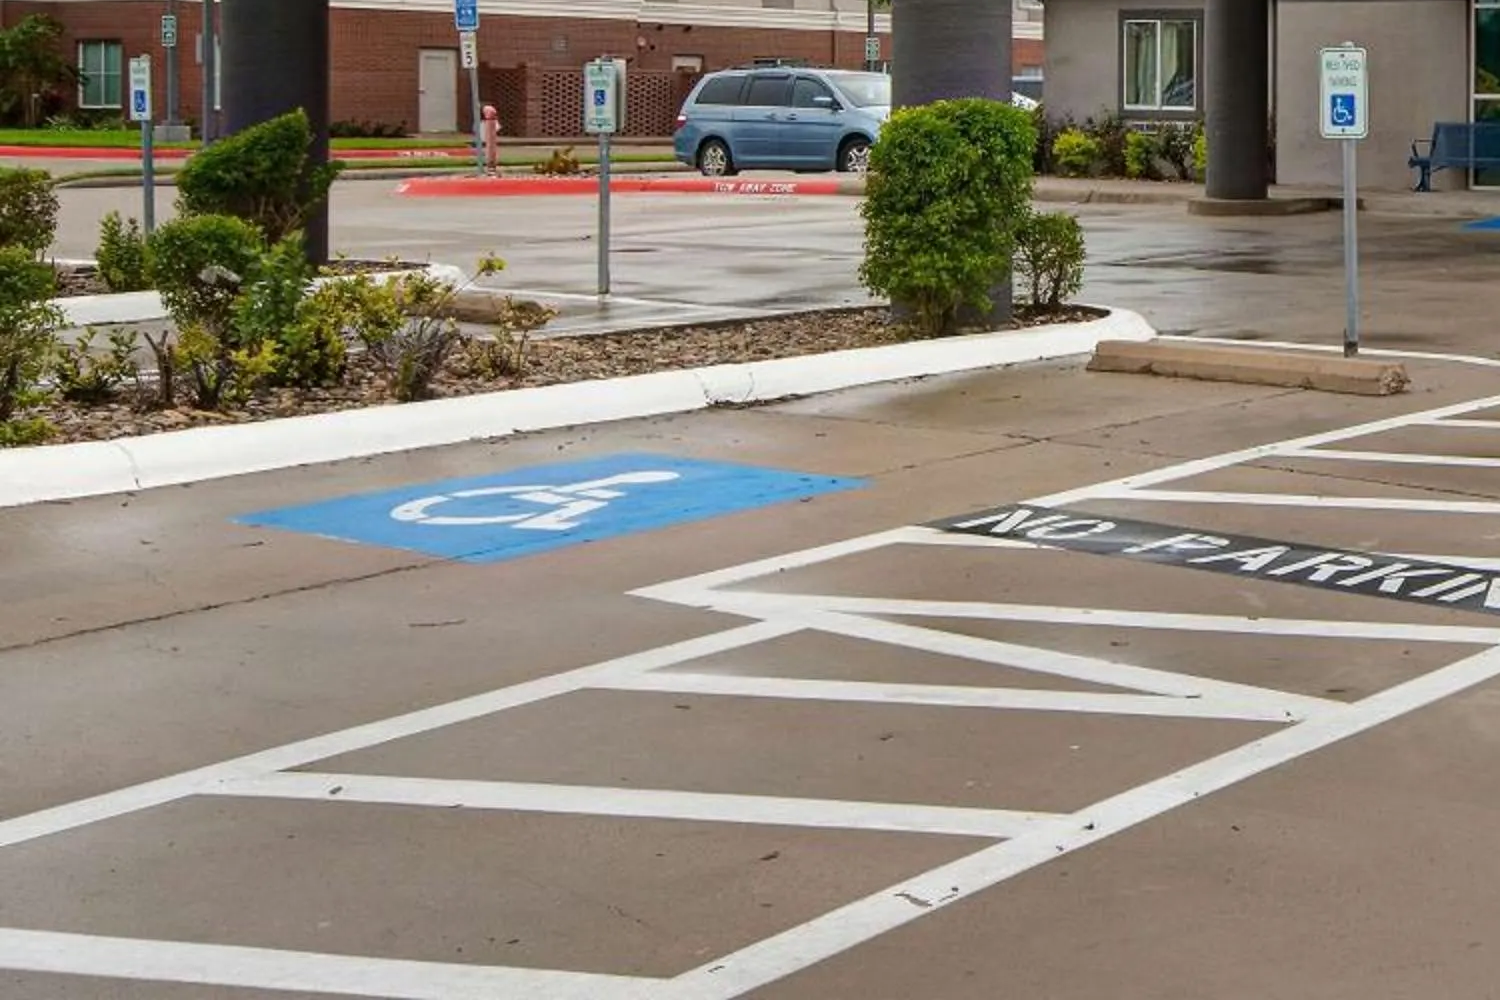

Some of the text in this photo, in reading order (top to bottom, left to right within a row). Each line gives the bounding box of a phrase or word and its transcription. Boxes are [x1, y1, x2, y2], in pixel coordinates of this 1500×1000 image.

[715, 182, 798, 193] TOW AWAY ZONE
[952, 508, 1117, 539] NO
